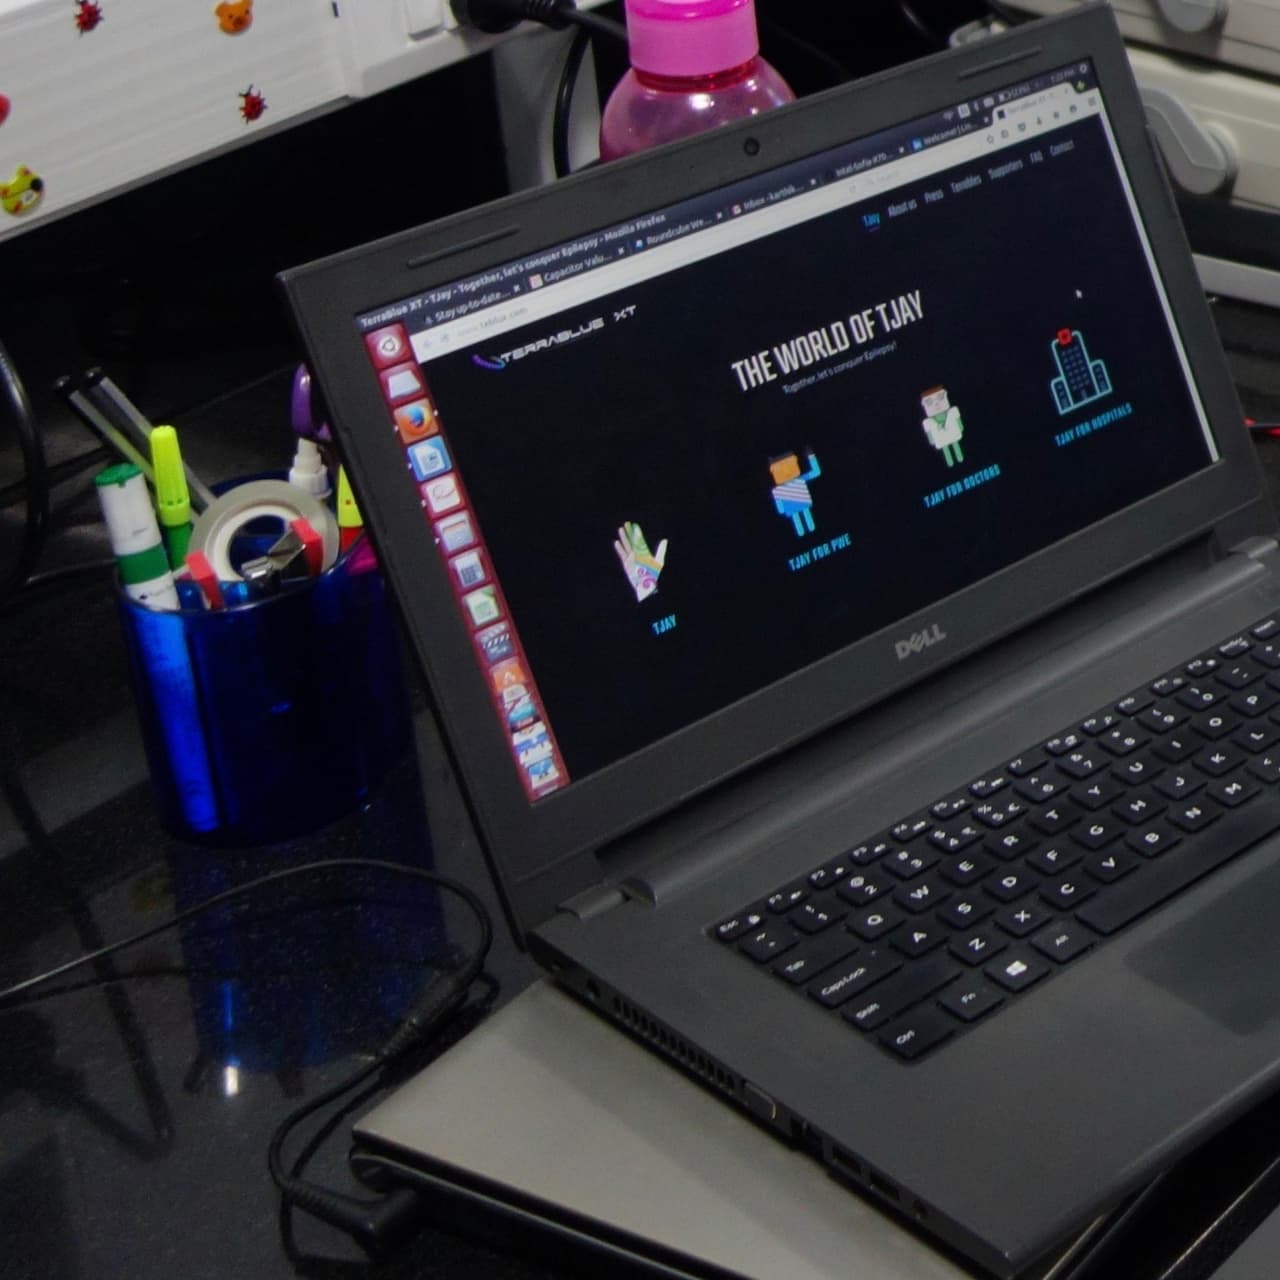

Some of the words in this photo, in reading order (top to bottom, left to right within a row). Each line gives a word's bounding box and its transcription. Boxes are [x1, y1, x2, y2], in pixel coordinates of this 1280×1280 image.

[923, 188, 944, 203] Press
[645, 223, 688, 246] Roundcube
[360, 304, 408, 327] TerraBlue
[409, 298, 422, 311] XT
[458, 270, 503, 294] Together,
[503, 262, 524, 277] let's
[524, 251, 560, 271] conquer
[559, 236, 598, 258] Epilepsy
[603, 223, 635, 241] Mozilla
[634, 212, 666, 229] Firefox
[542, 260, 584, 282] Capacitor
[434, 306, 455, 321] Stay
[500, 317, 605, 363] TERRABLUE
[613, 305, 637, 322] XT
[731, 350, 778, 391] THE
[773, 320, 851, 375] WORLD
[850, 308, 876, 345] OF
[875, 289, 924, 333] TJAY
[1055, 429, 1075, 447] TJAY
[1075, 421, 1092, 439] FOR
[1092, 402, 1133, 430] HOSPITALS
[923, 489, 945, 508] TJAY
[945, 480, 963, 499] FOR
[963, 464, 1001, 492] DOCTORS
[788, 553, 811, 573] TJAY
[812, 543, 831, 562] FOR
[652, 614, 677, 636] TJAY
[895, 623, 947, 660] DELL
[867, 914, 884, 926] Q
[910, 885, 929, 899] W
[958, 860, 974, 872] E
[1003, 835, 1019, 847] R
[1045, 809, 1059, 820] T
[1087, 785, 1101, 795] Y
[1129, 761, 1144, 773] U
[1246, 695, 1258, 705] P
[913, 932, 927, 943] A
[957, 902, 972, 915] S
[1001, 876, 1017, 888] D
[1046, 849, 1058, 862] F
[1089, 825, 1104, 836] G
[1130, 799, 1147, 812] H
[1175, 776, 1185, 787] J
[1210, 752, 1226, 764] K
[1250, 732, 1265, 741] L
[968, 937, 986, 951] Z
[1014, 909, 1031, 923] X
[1060, 883, 1075, 895] C
[1101, 856, 1116, 868] V
[1144, 832, 1160, 844] B
[1225, 782, 1242, 795] M
